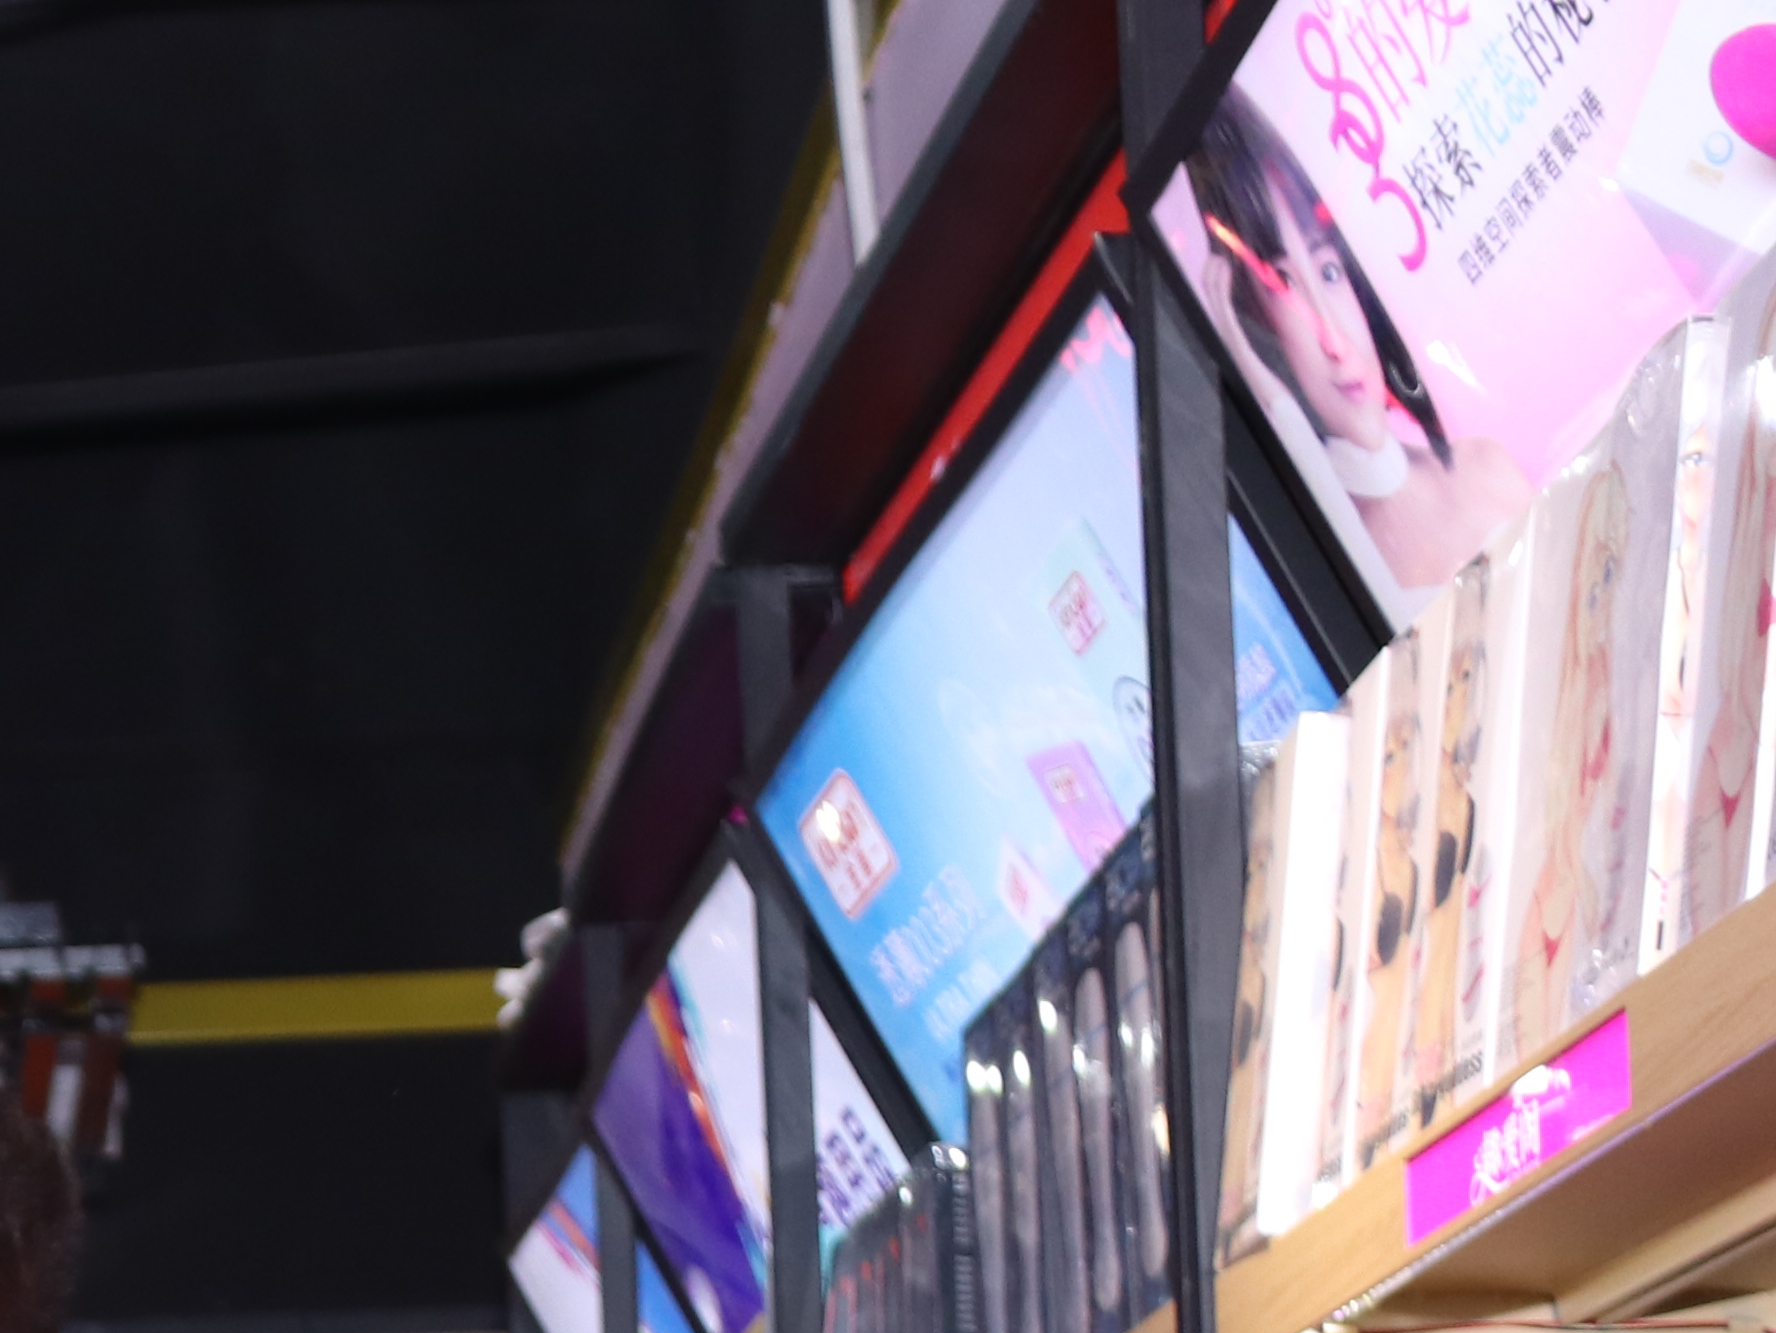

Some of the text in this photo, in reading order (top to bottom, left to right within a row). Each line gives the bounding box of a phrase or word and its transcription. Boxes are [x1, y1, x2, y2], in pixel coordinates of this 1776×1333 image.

[1401, 0, 1614, 232] 探索花蕊的秘
